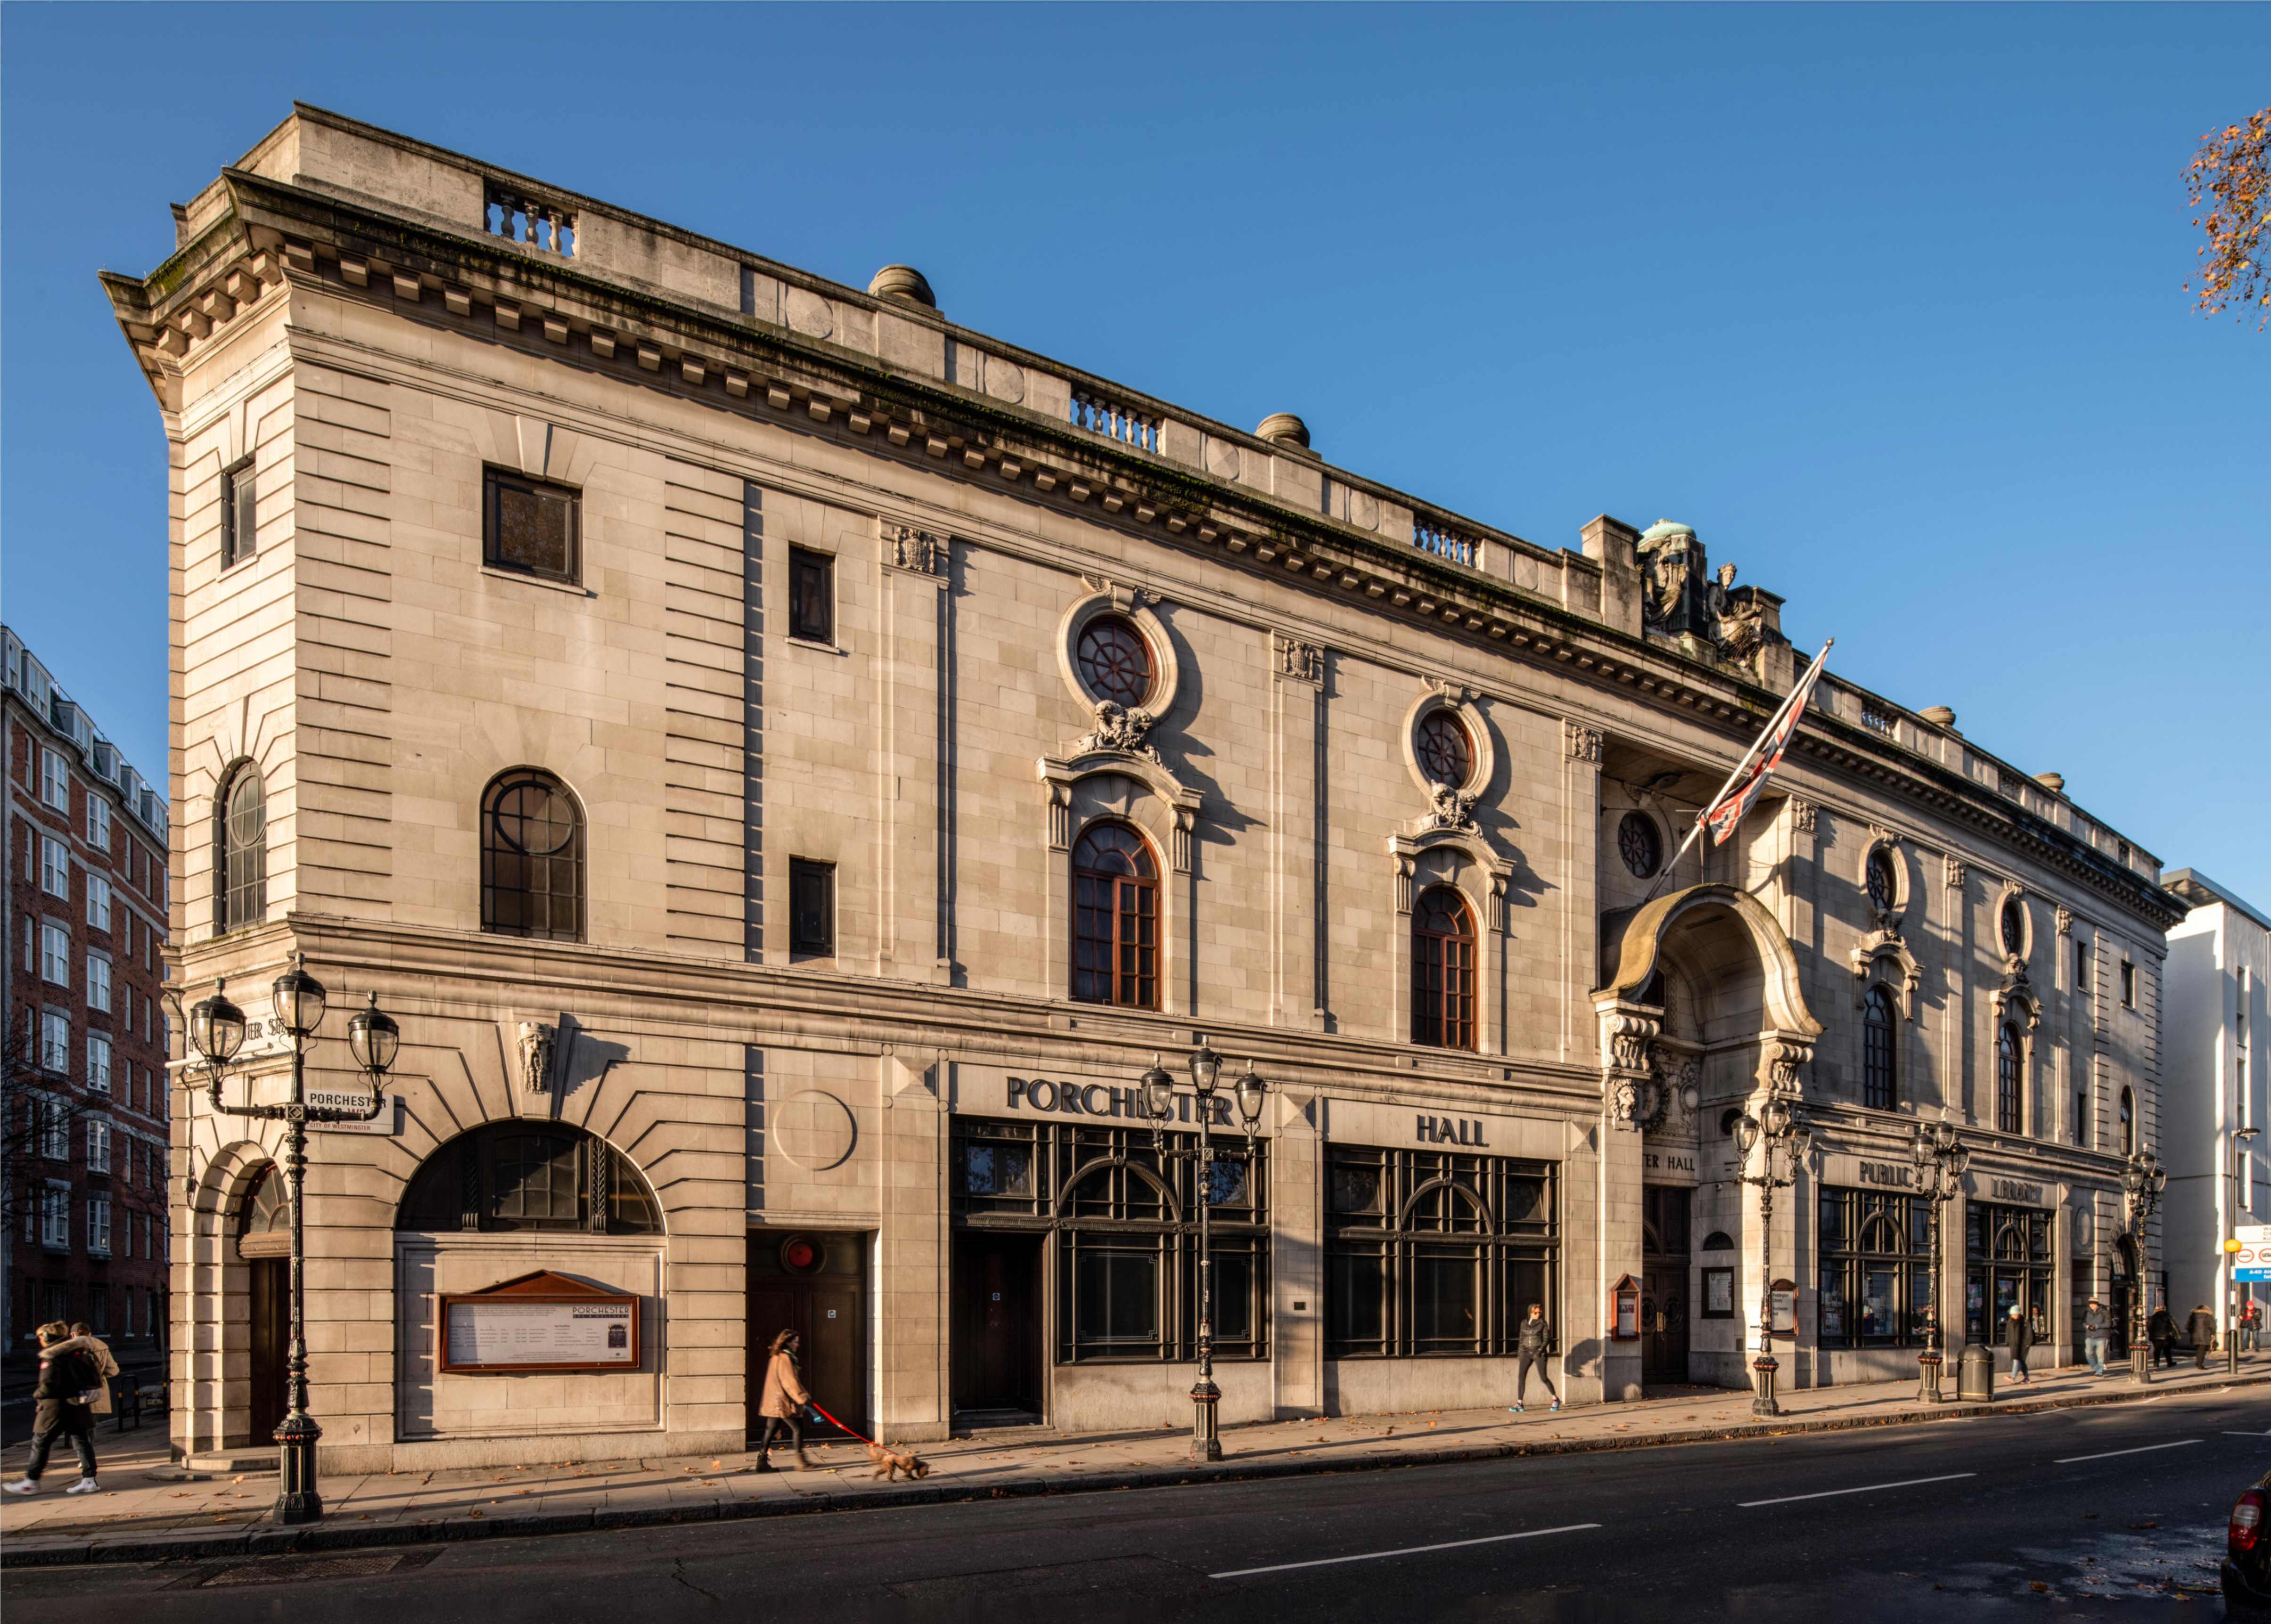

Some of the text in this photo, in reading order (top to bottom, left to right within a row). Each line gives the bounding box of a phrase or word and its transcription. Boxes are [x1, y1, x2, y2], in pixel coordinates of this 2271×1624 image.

[310, 1093, 386, 1108] PORCHESTR
[1007, 1076, 1232, 1126] PORCHETER
[1417, 1114, 1490, 1148] HALL
[1668, 1156, 1695, 1172] HALL
[1860, 1161, 1913, 1188] PUBLIC
[1991, 1178, 2042, 1204] LIBRARY
